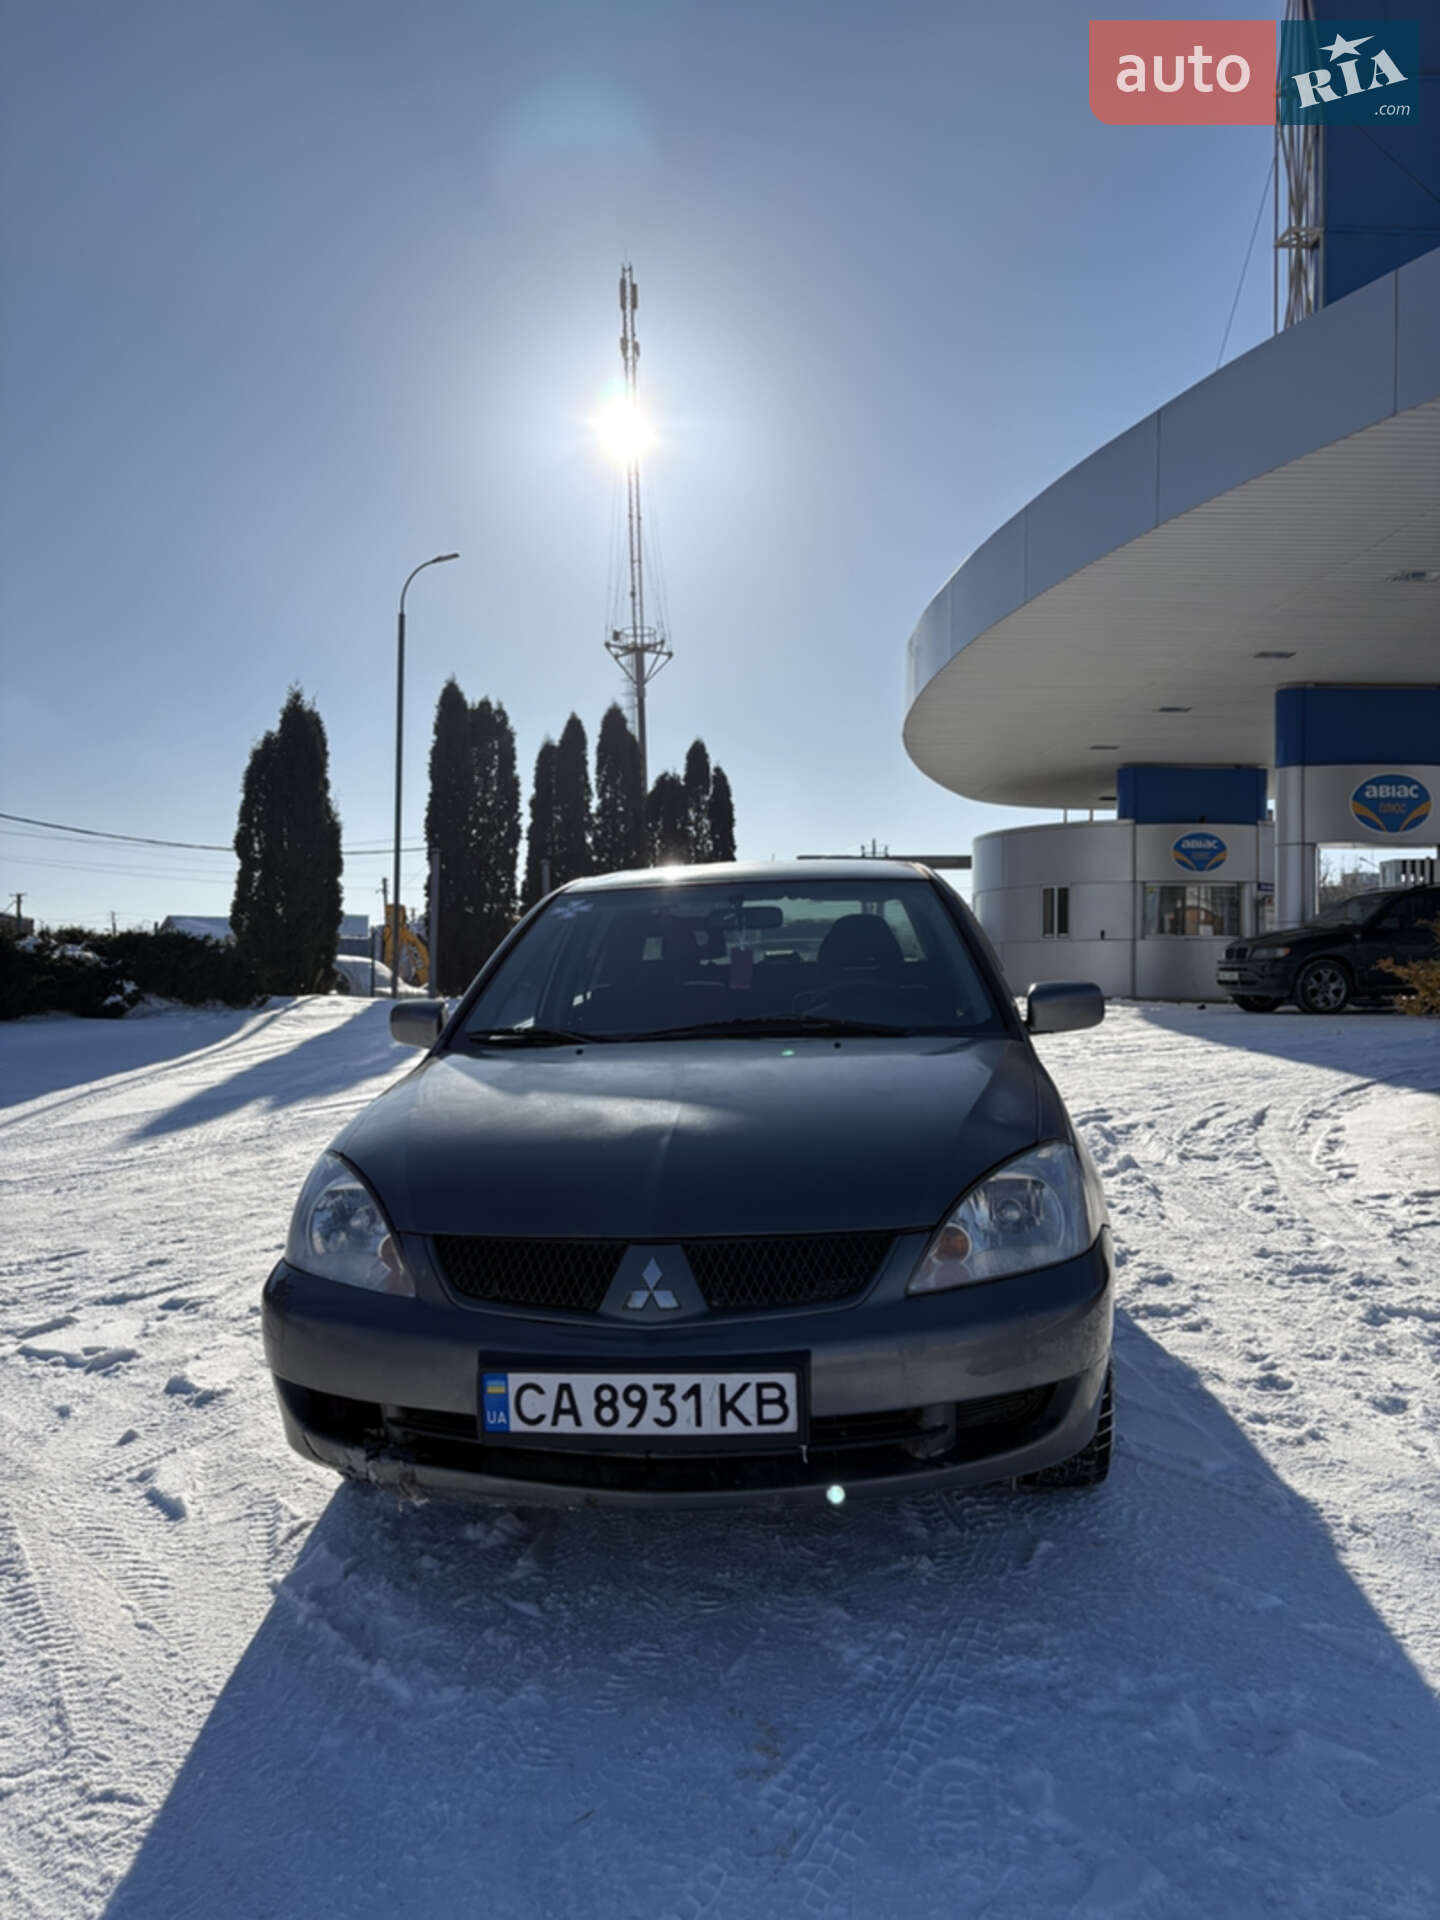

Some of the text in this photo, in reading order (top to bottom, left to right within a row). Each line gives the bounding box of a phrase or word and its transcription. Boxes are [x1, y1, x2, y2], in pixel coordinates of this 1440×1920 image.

[486, 1411, 508, 1425] UA
[514, 1381, 790, 1428] CA 8931 KB
